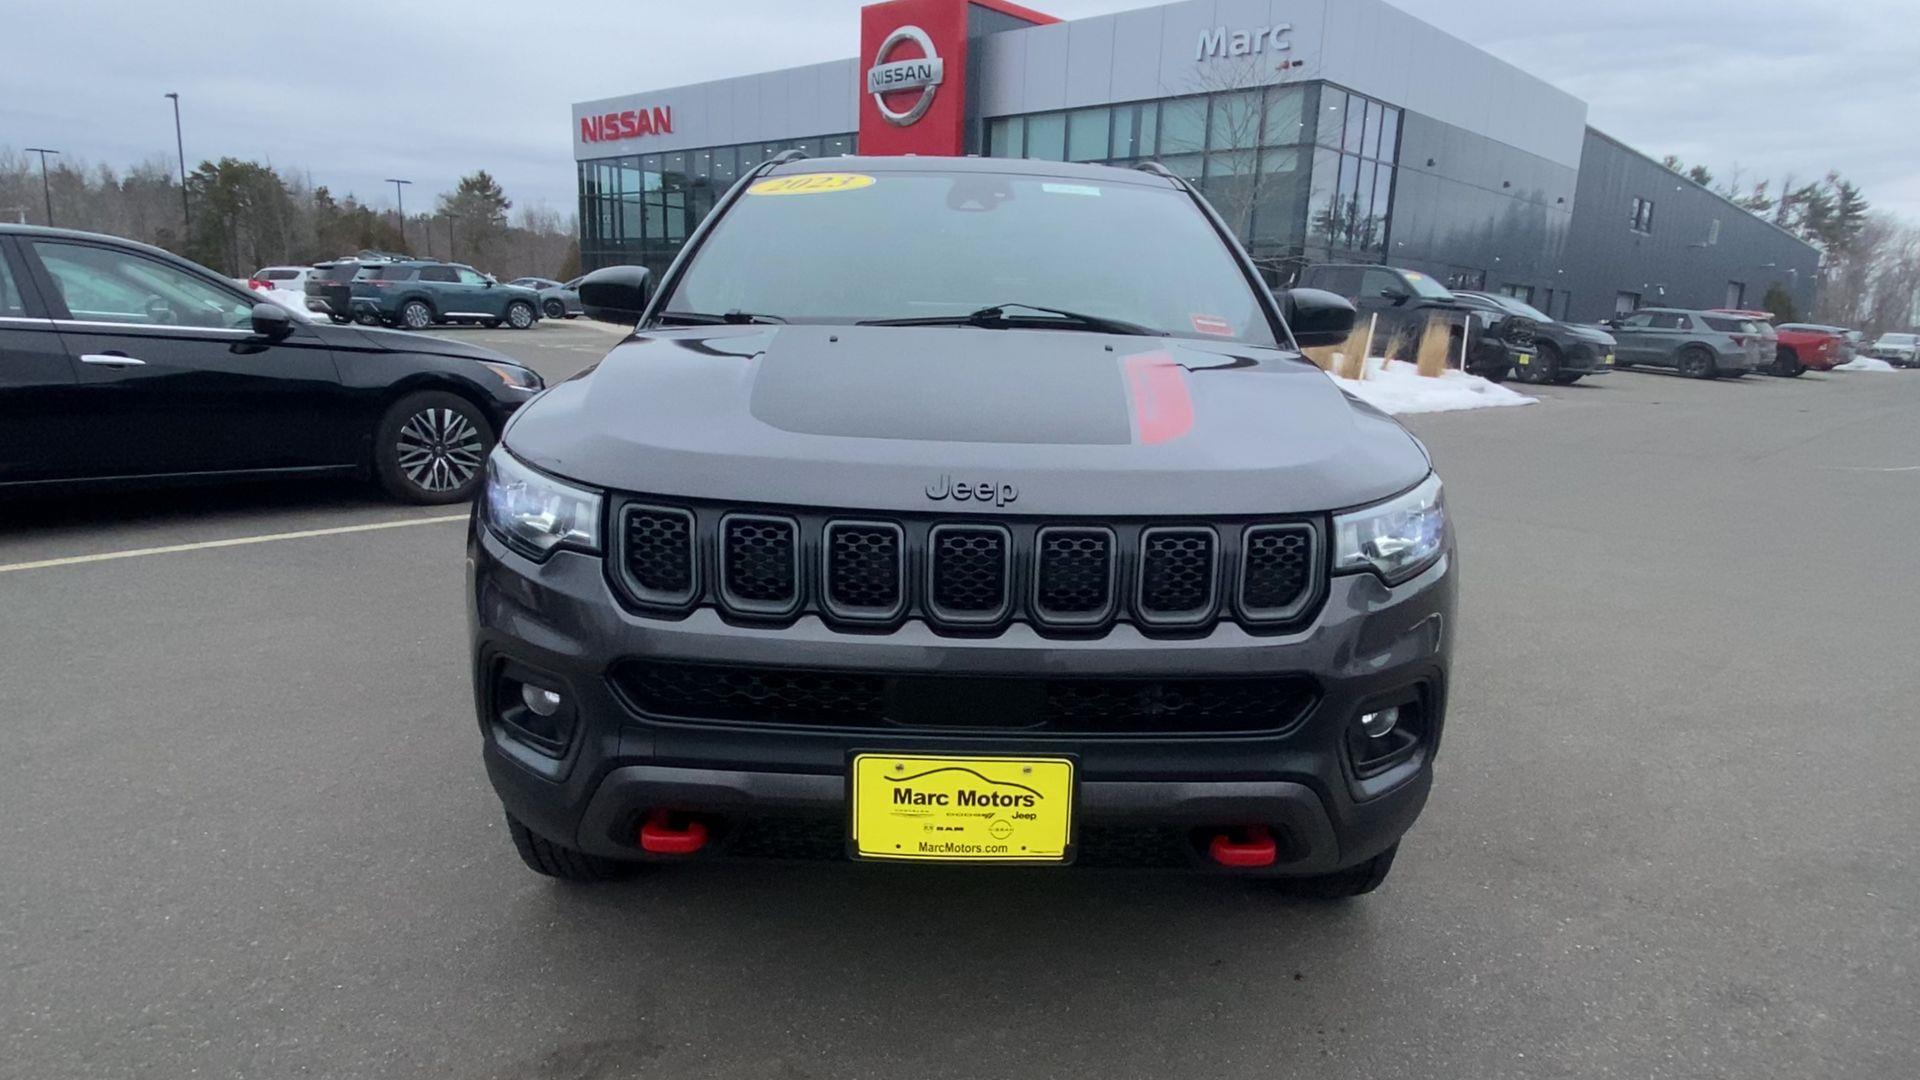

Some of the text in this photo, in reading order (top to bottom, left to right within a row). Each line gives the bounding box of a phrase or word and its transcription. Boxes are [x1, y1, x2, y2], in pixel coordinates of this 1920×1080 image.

[1195, 23, 1292, 62] Marc
[872, 64, 931, 85] NISSAN
[580, 105, 673, 143] NISSAN
[924, 474, 1019, 507] Jeep
[893, 788, 1035, 807] Marc Motors
[1011, 811, 1037, 820] Jeep
[918, 841, 1008, 853] MarcMotors.com
